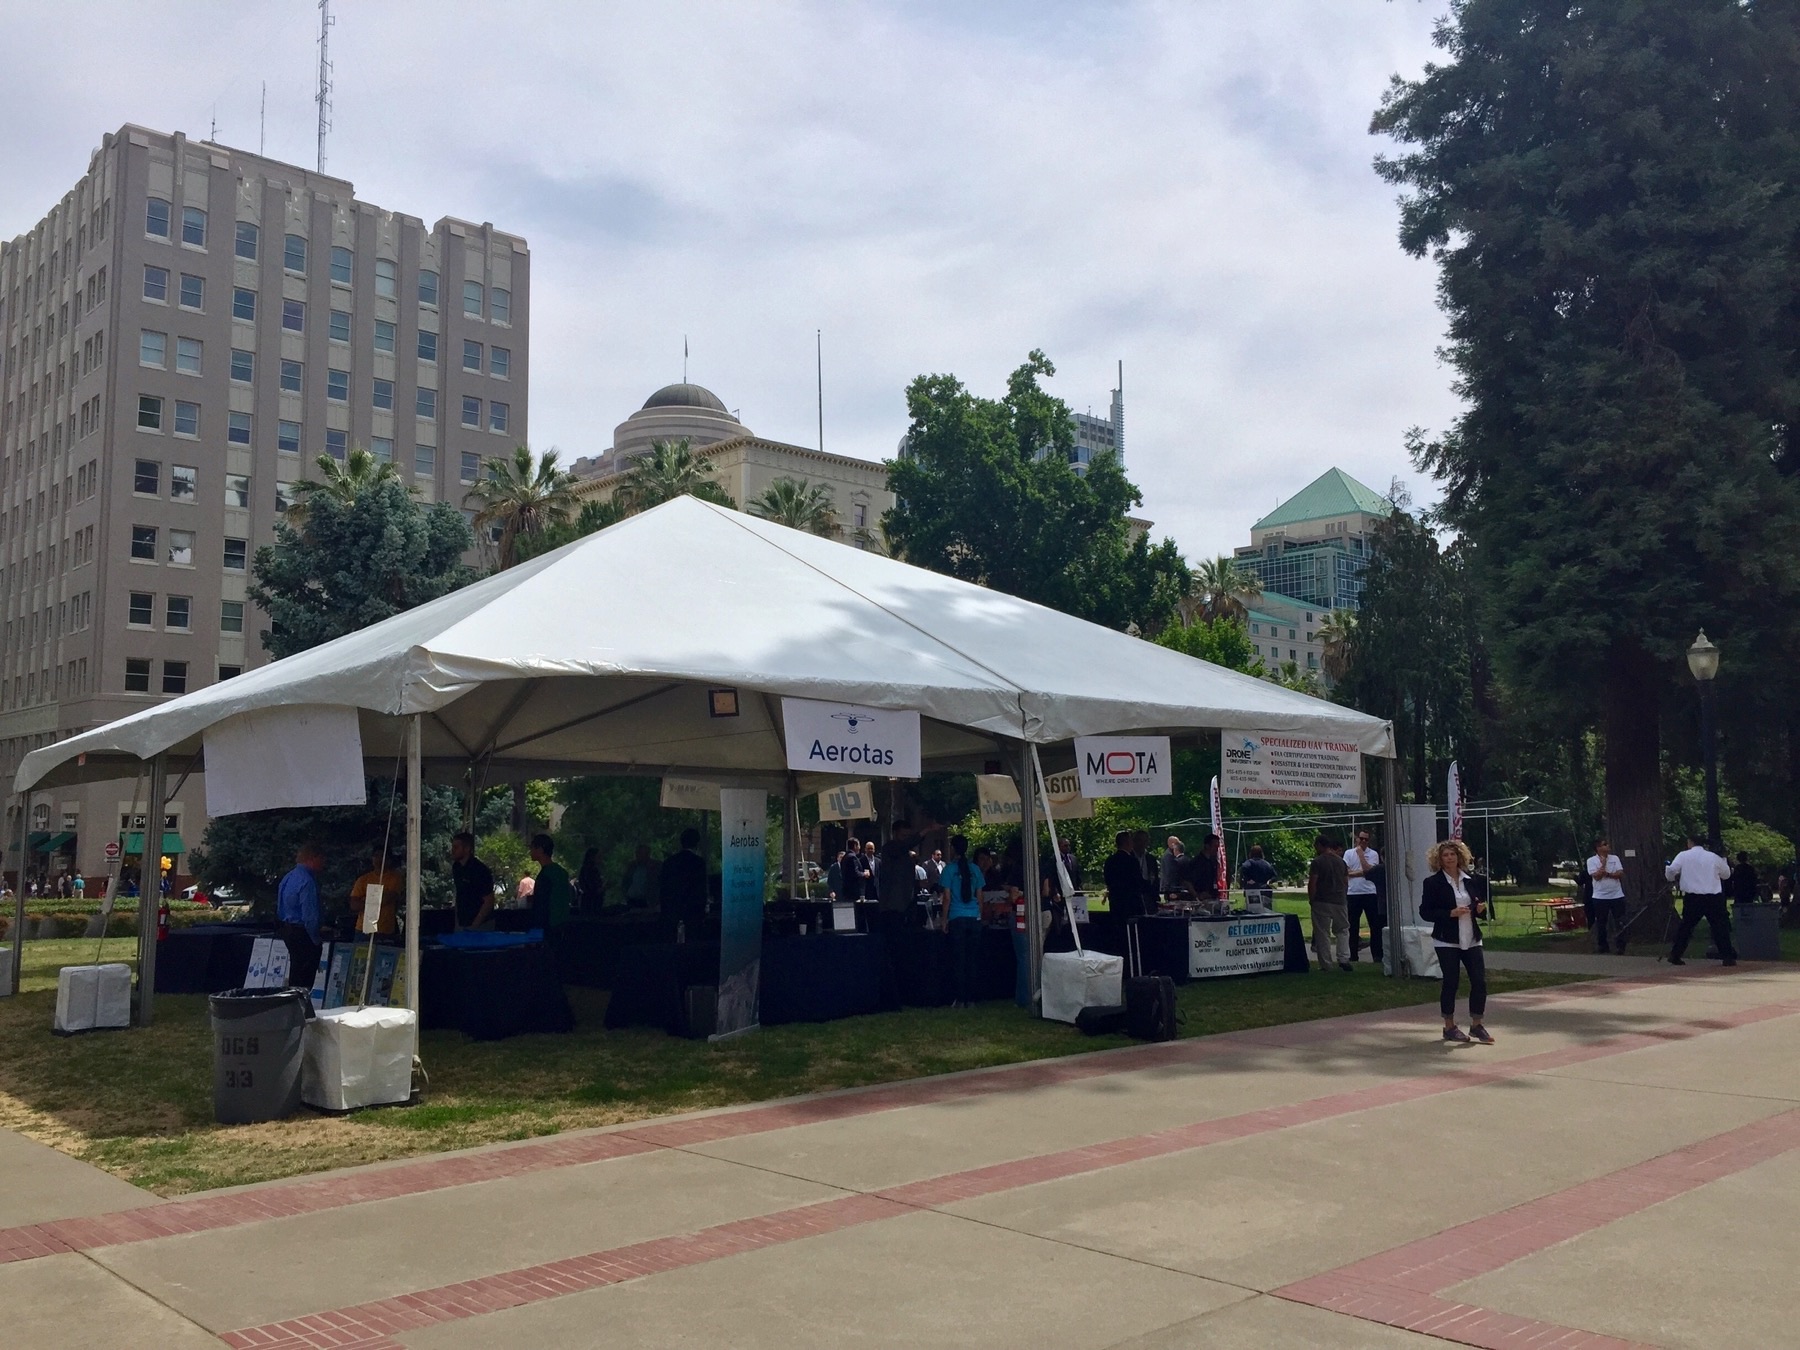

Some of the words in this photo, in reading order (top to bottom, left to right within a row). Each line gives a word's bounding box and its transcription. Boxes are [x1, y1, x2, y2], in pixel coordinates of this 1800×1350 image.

[1260, 736, 1307, 750] SPECIALIZED
[1308, 740, 1323, 751] UAV
[1324, 742, 1359, 753] TRAINING
[809, 739, 894, 766] Aerotas
[1226, 749, 1252, 760] DRONE
[1283, 752, 1317, 761] CERTIFICATION
[1317, 754, 1340, 762] TRAINING
[1086, 751, 1158, 776] MOTA
[1274, 760, 1297, 768] DISASTER
[1310, 762, 1336, 771] RESPONDER
[1336, 764, 1357, 772] TRAINING
[1275, 770, 1299, 778] ADVANCED
[1300, 771, 1315, 779] AERIAL
[1316, 772, 1357, 781] CINEMATOGRAPHY
[1309, 781, 1342, 789] CERTIFICATION
[1242, 787, 1310, 798] droneuniversityusa.com
[730, 835, 760, 848] Aerotas
[1228, 925, 1241, 936] GET
[1243, 922, 1281, 935] CERTIFIED
[1236, 938, 1253, 946] CLASS
[1253, 936, 1270, 945] ROOM
[1226, 949, 1245, 957] FLIGHT
[1246, 947, 1259, 955] LINE
[1260, 945, 1285, 954] TRAINING
